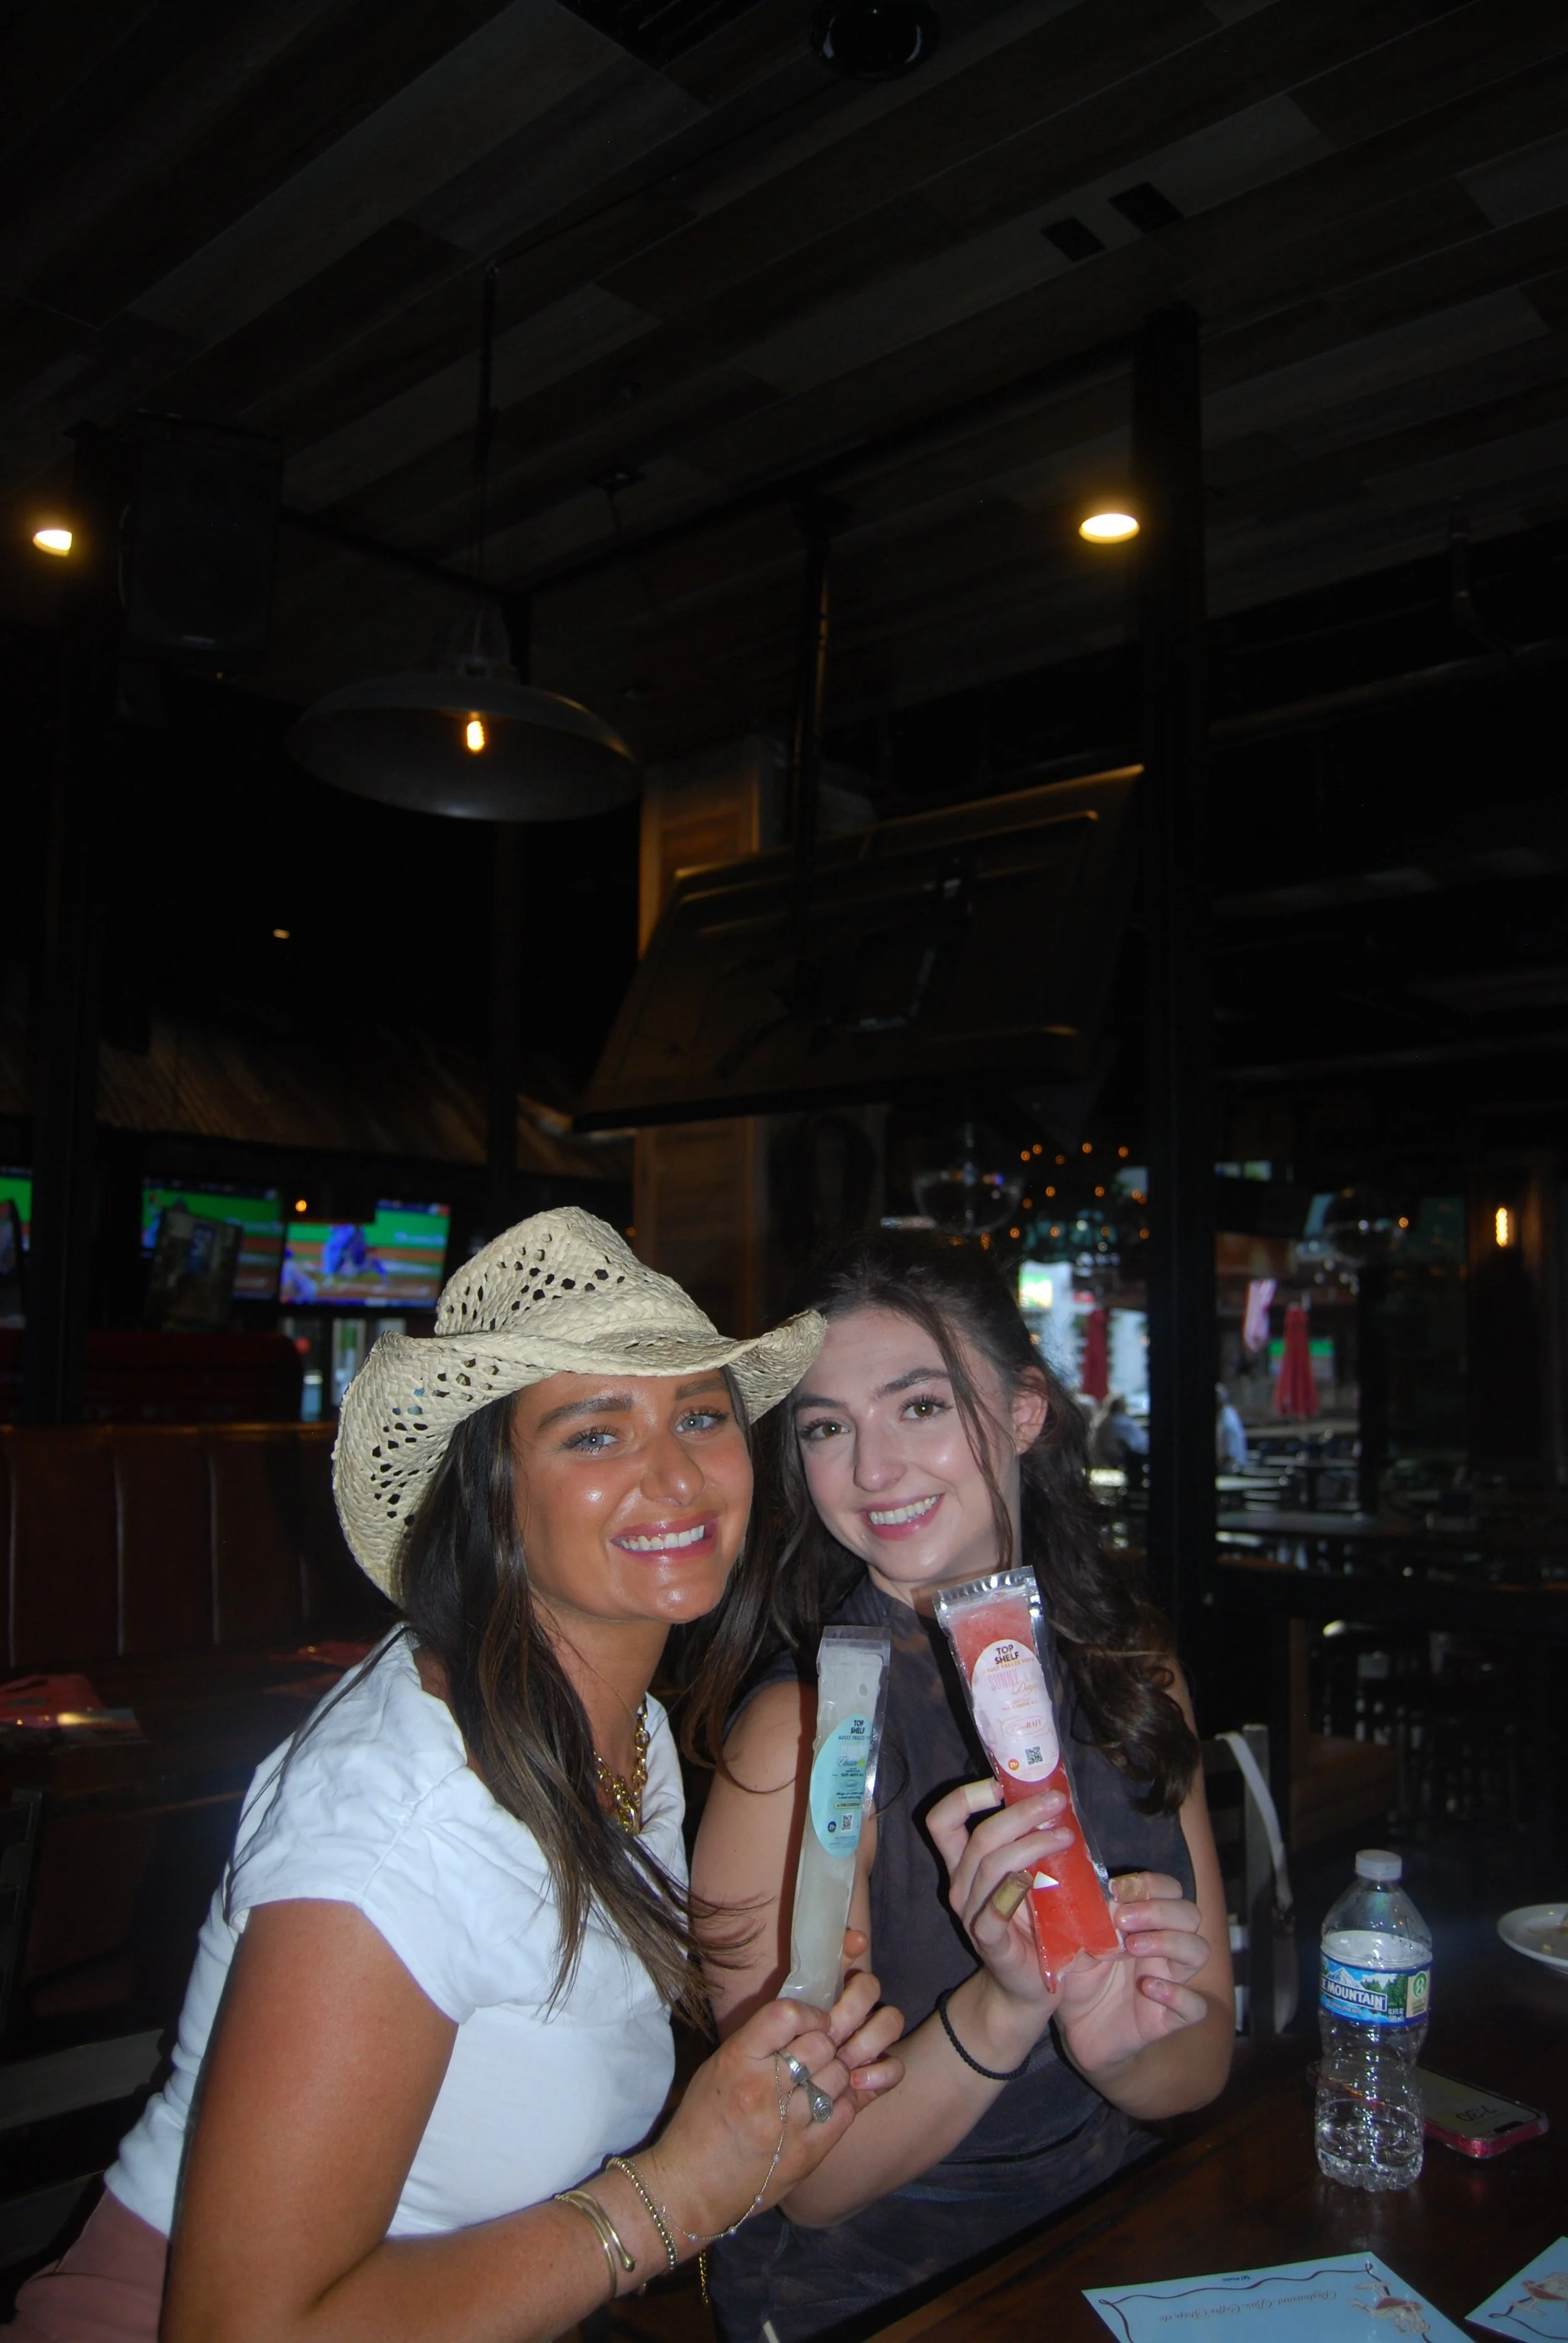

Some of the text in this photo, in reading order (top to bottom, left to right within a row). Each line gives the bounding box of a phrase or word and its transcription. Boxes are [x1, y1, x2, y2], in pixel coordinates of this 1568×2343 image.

[996, 1644, 1014, 1655] TOP
[995, 1652, 1019, 1664] SHELF
[983, 1666, 999, 1674] ADULT
[988, 1669, 1019, 1691] SUNNY
[1327, 1980, 1383, 2007] MOUNTAIN
[1456, 2105, 1497, 2122] 7:30
